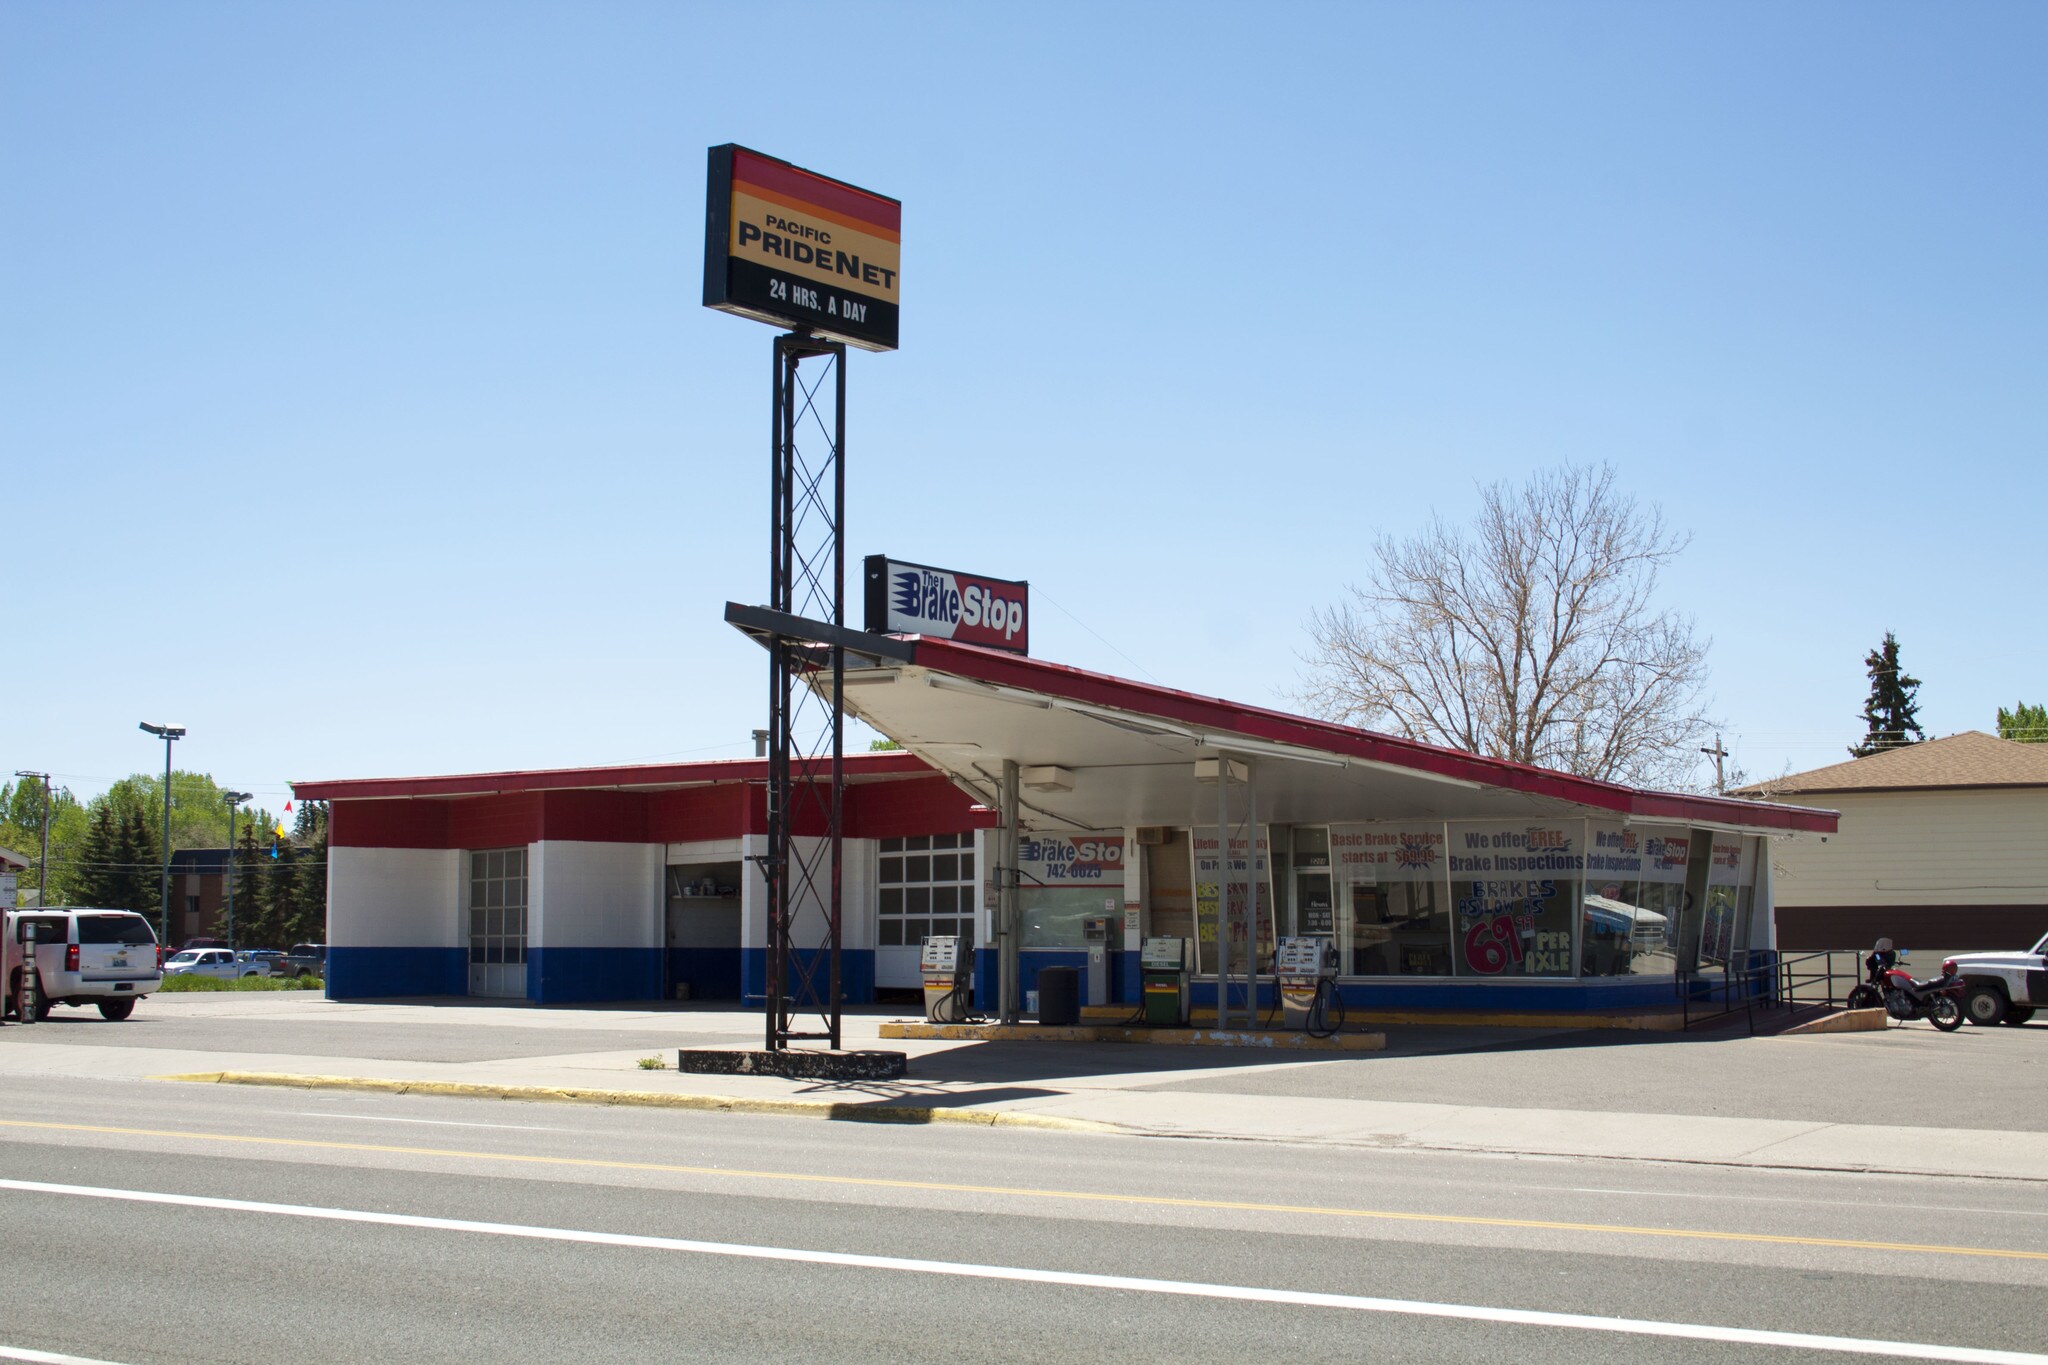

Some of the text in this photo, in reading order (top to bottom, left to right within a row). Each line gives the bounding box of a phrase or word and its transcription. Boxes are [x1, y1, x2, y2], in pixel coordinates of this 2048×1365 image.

[766, 214, 831, 245] PACIFIC
[738, 220, 896, 290] PRIDENET
[769, 278, 867, 323] 24 HRS. A DAY
[922, 571, 939, 587] The
[891, 571, 1023, 641] Brake Stop
[1043, 838, 1057, 846] The
[1332, 832, 1443, 846] Basic Brake Service
[1465, 830, 1564, 848] We offer FREE
[1596, 831, 1606, 847] We
[1019, 841, 1075, 862] Brake
[1342, 851, 1374, 863] starts
[1377, 851, 1388, 863] at
[1666, 842, 1686, 861] Stop
[1200, 859, 1211, 870] On
[1233, 859, 1246, 870] We
[1449, 854, 1584, 872] Brake Inspections
[1587, 853, 1641, 872] Brake Inspections
[1472, 880, 1557, 899] BRAKES
[1458, 898, 1545, 915] AS LOW AS
[1536, 931, 1570, 950] PER
[1525, 951, 1570, 973] AXLE
